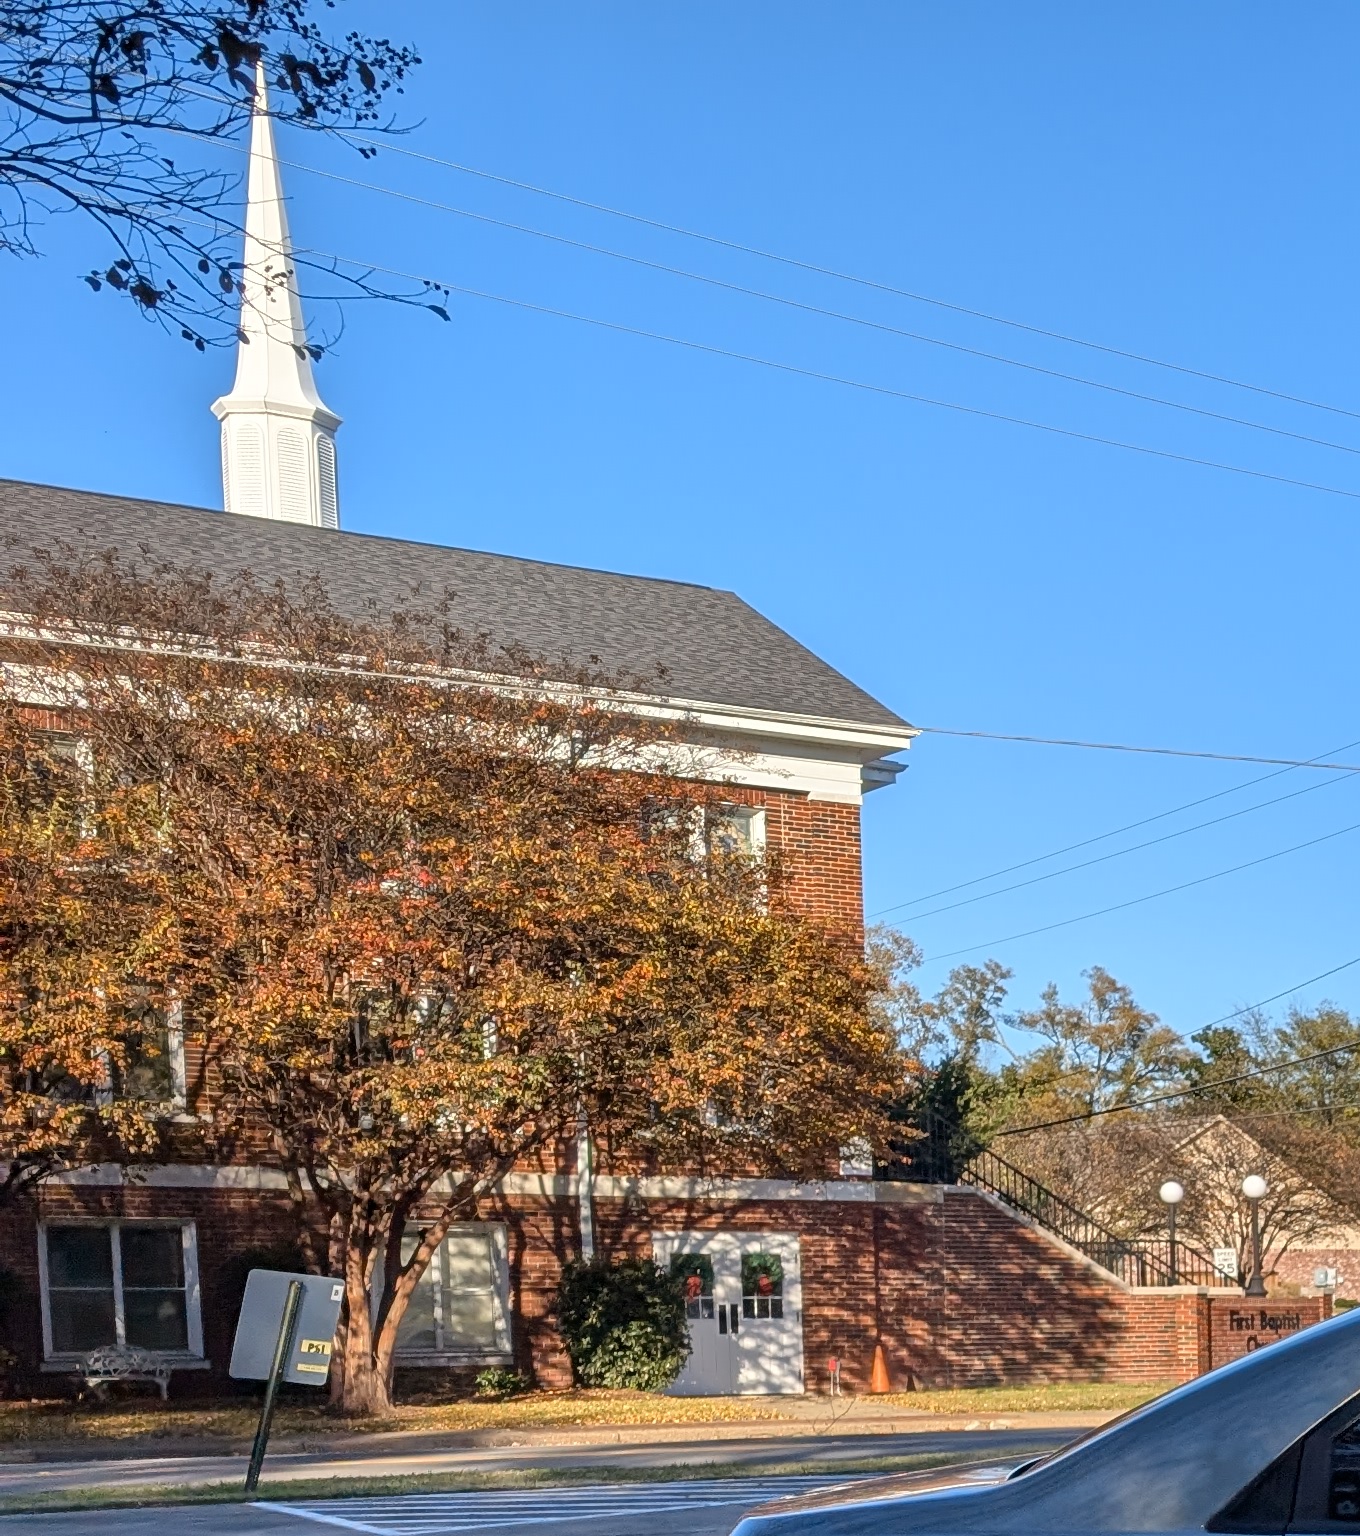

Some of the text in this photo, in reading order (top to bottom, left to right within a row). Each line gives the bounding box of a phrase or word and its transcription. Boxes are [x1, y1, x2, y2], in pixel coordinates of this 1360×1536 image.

[1217, 1263, 1235, 1274] 25
[1229, 1310, 1300, 1335] First Baptist
